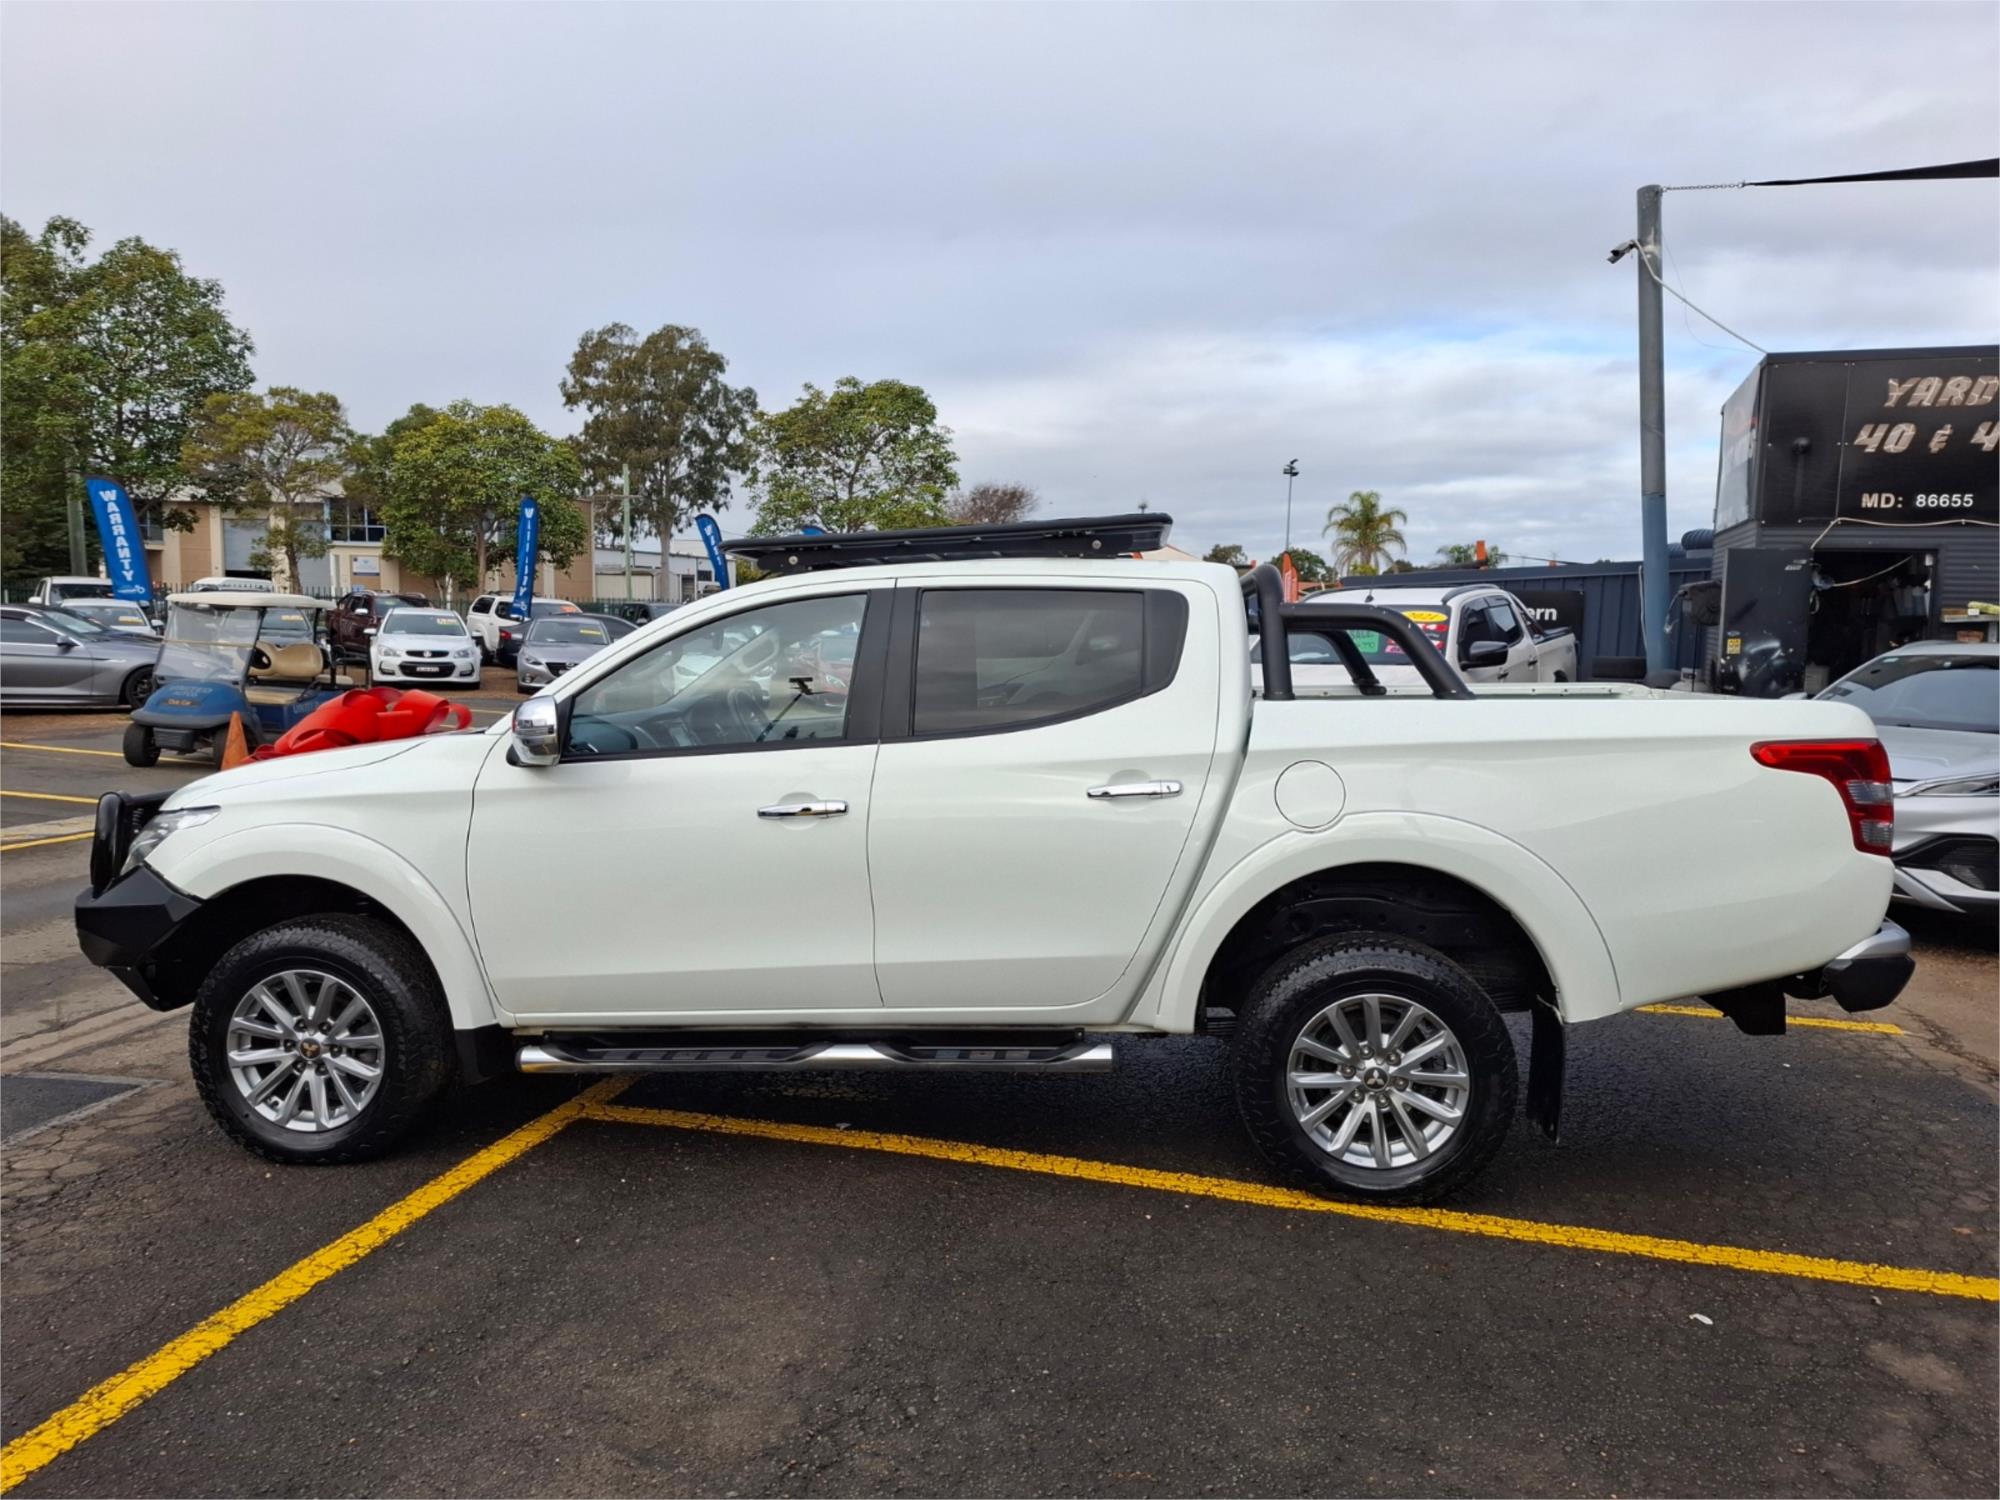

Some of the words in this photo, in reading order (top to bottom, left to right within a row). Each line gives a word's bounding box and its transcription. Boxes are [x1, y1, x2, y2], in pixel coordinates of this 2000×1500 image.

[1853, 422, 1917, 453] 40
[1861, 492, 1903, 508] MD:
[1915, 493, 1974, 507] 86655
